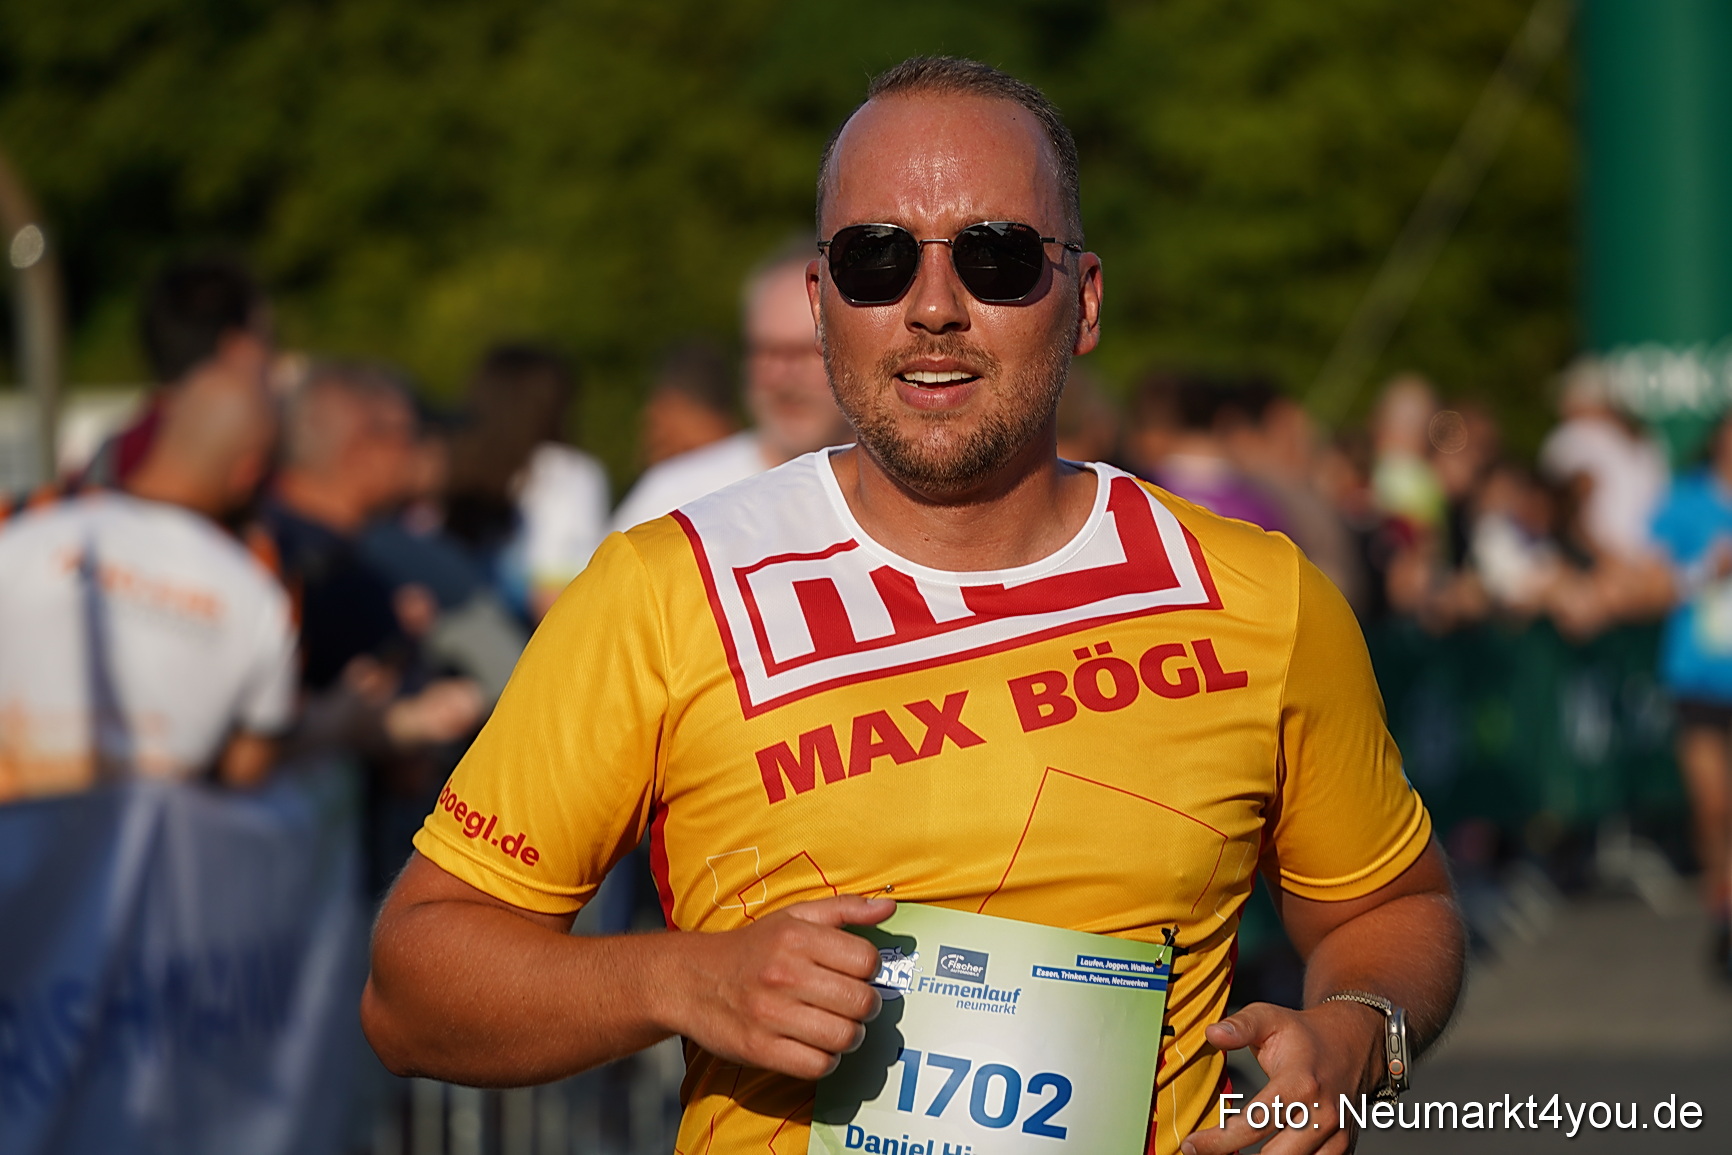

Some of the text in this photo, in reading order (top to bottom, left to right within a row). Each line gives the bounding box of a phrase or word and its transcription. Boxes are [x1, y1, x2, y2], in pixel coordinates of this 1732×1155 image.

[754, 638, 1248, 805] MAX BÖGL
[948, 955, 984, 973] Fischer
[1080, 957, 1155, 973] Laufen, Joggen, Walken
[1036, 967, 1149, 988] Essen, Trinken, Feiern, Netzwerken
[917, 976, 1022, 1004] Firmenlauf
[956, 999, 1017, 1015] neumarkt
[897, 1046, 1073, 1140] 1702
[845, 1123, 935, 1155] Daniel
